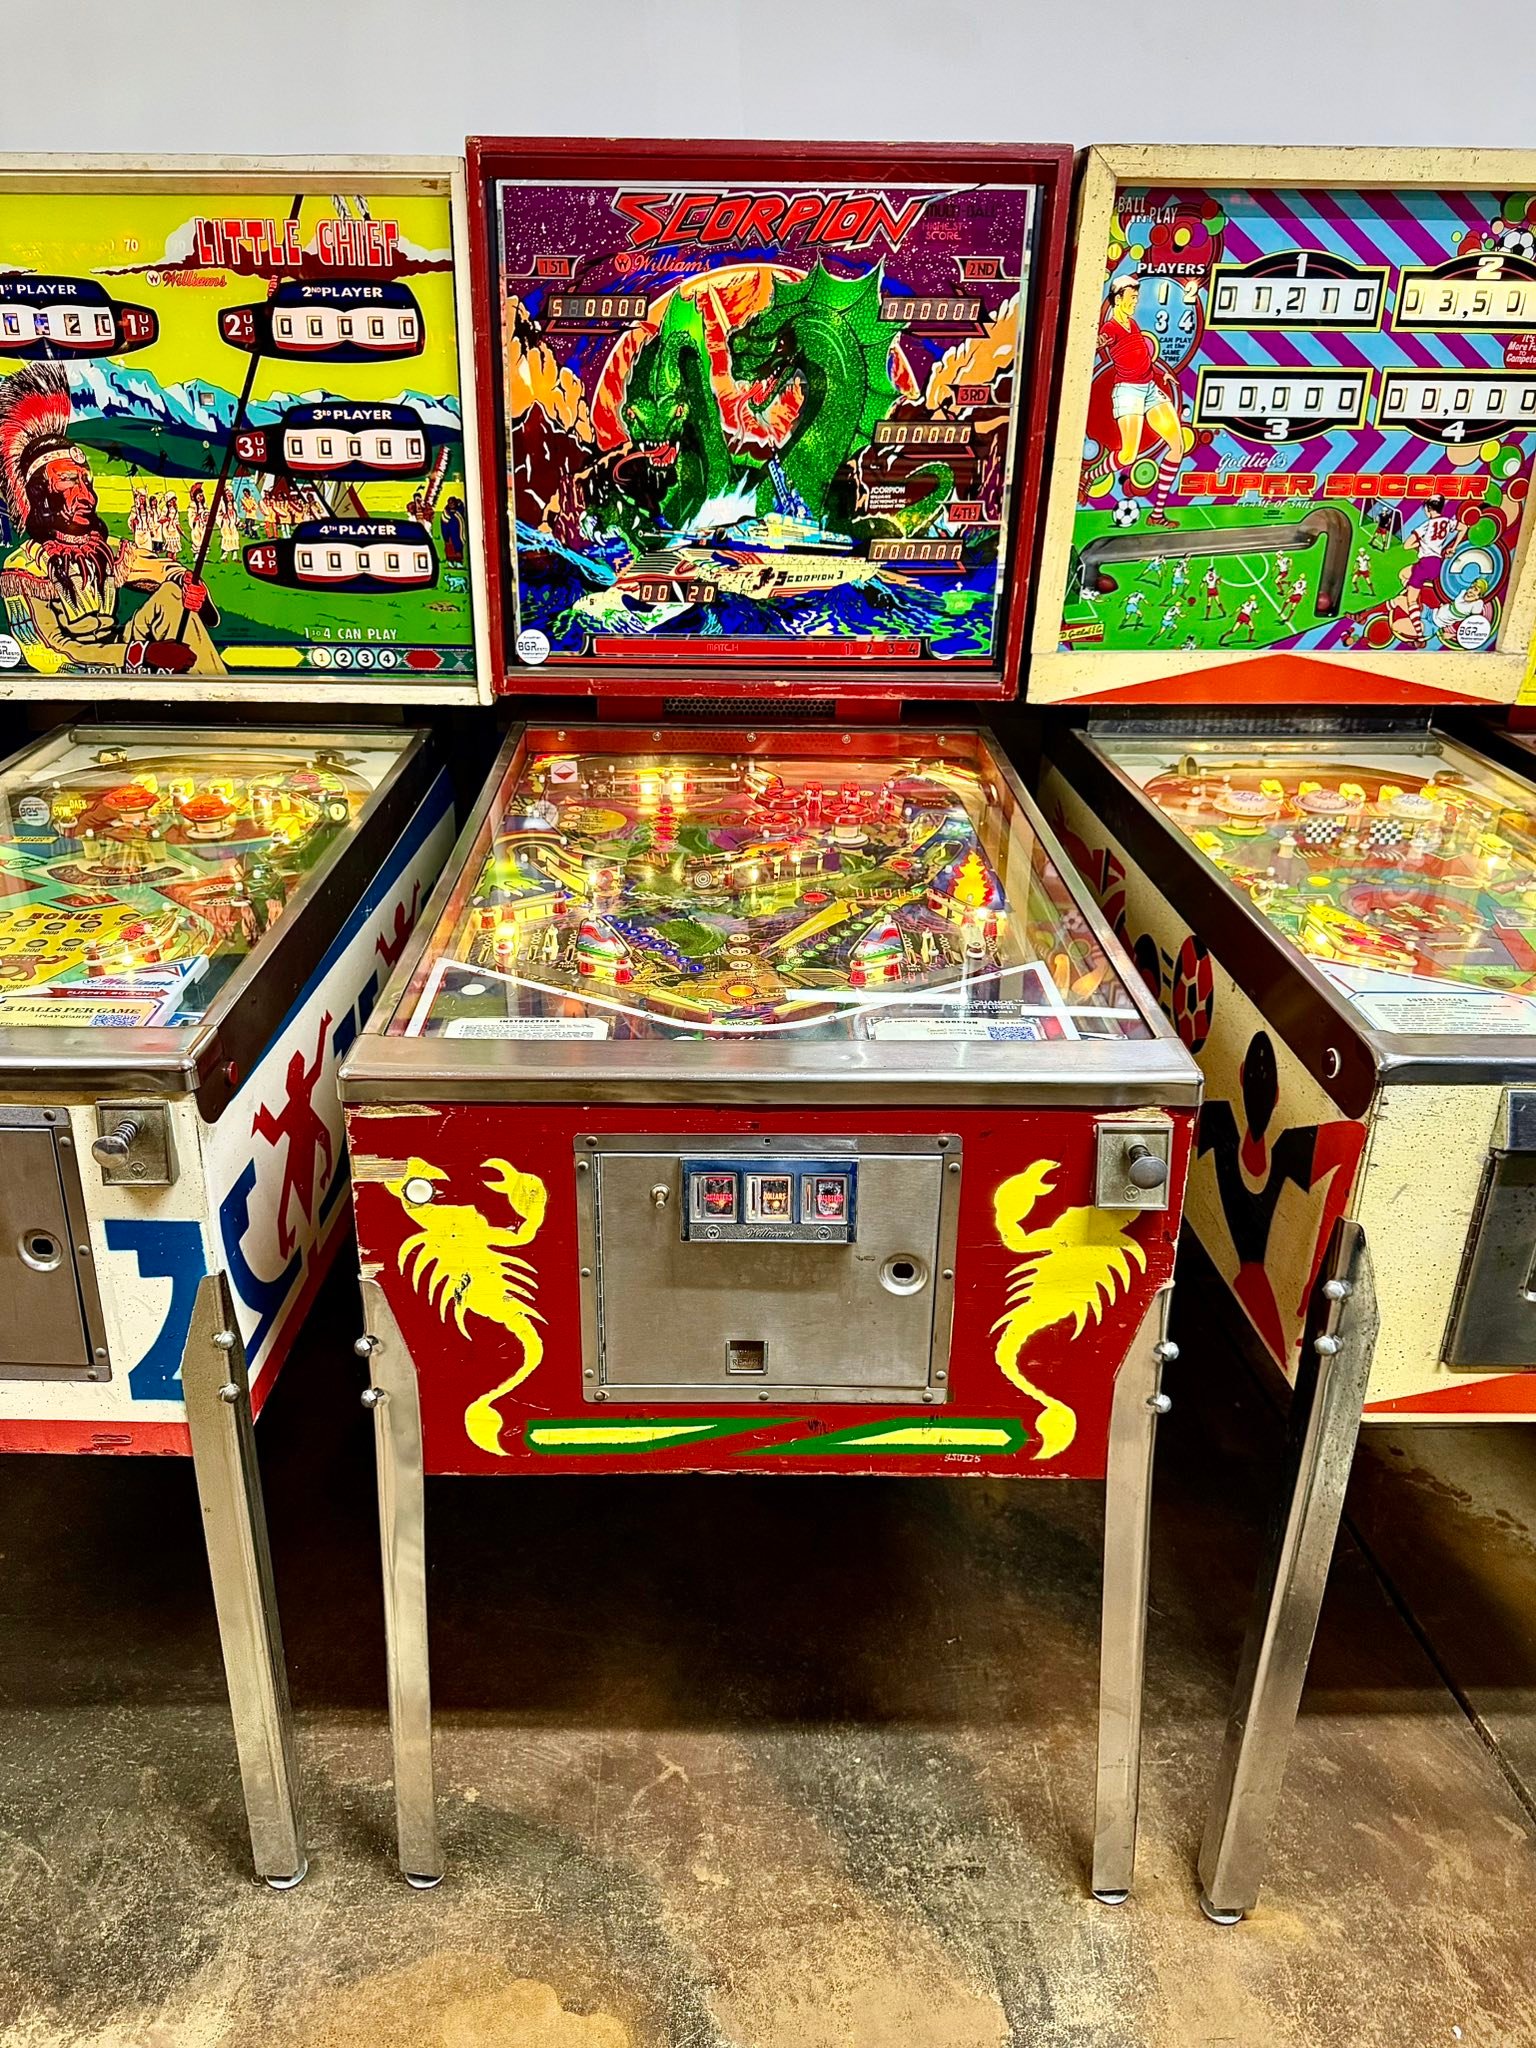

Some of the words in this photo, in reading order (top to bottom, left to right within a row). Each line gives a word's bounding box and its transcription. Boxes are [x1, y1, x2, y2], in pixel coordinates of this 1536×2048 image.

[1117, 197, 1145, 213] BALL
[612, 190, 926, 250] SCORPION
[1150, 207, 1178, 224] PLAY
[196, 219, 302, 266] LITTLE
[316, 219, 399, 267] CHIEF
[925, 231, 962, 240] SCORE
[124, 239, 139, 252] 70
[543, 260, 565, 274] 1ST
[632, 254, 712, 272] Williams
[969, 263, 994, 275] 2ND
[1137, 263, 1206, 275] PLAYERS
[1296, 253, 1308, 278] 1
[1476, 256, 1504, 280] 2
[163, 272, 227, 287] Williams
[17, 284, 77, 295] PLAYER
[302, 287, 321, 297] 2ND
[322, 287, 383, 298] PLAYER
[1159, 282, 1169, 304] 1
[1183, 281, 1198, 304] 2
[127, 315, 138, 336] 1
[225, 315, 241, 336] 2
[1154, 310, 1169, 333] 3
[1178, 311, 1194, 333] 4
[960, 389, 986, 401] 3RD
[334, 409, 392, 420] PLAYER
[1264, 418, 1290, 440] 3
[1441, 421, 1465, 442] 4
[238, 437, 254, 458] 3
[1215, 451, 1288, 473] Gottlieb's
[1178, 472, 1317, 498] SUPER
[1323, 473, 1491, 499] SOCCER
[1290, 500, 1316, 509] SKILL
[319, 525, 338, 535] 4TH
[339, 525, 397, 536] PLAYER
[1431, 520, 1449, 542] 18
[250, 549, 264, 568] 4
[773, 571, 834, 586] SCORPION
[1208, 572, 1215, 581] 5
[688, 585, 714, 602] 20
[324, 628, 331, 639] 4
[337, 628, 362, 639] CAN
[368, 628, 398, 639] PLAY
[707, 643, 739, 652] MATCH
[340, 653, 349, 663] 2
[361, 653, 370, 663] 3
[383, 653, 392, 663] 4
[29, 912, 103, 920] BONUS
[763, 1192, 787, 1201] DOLLARS
